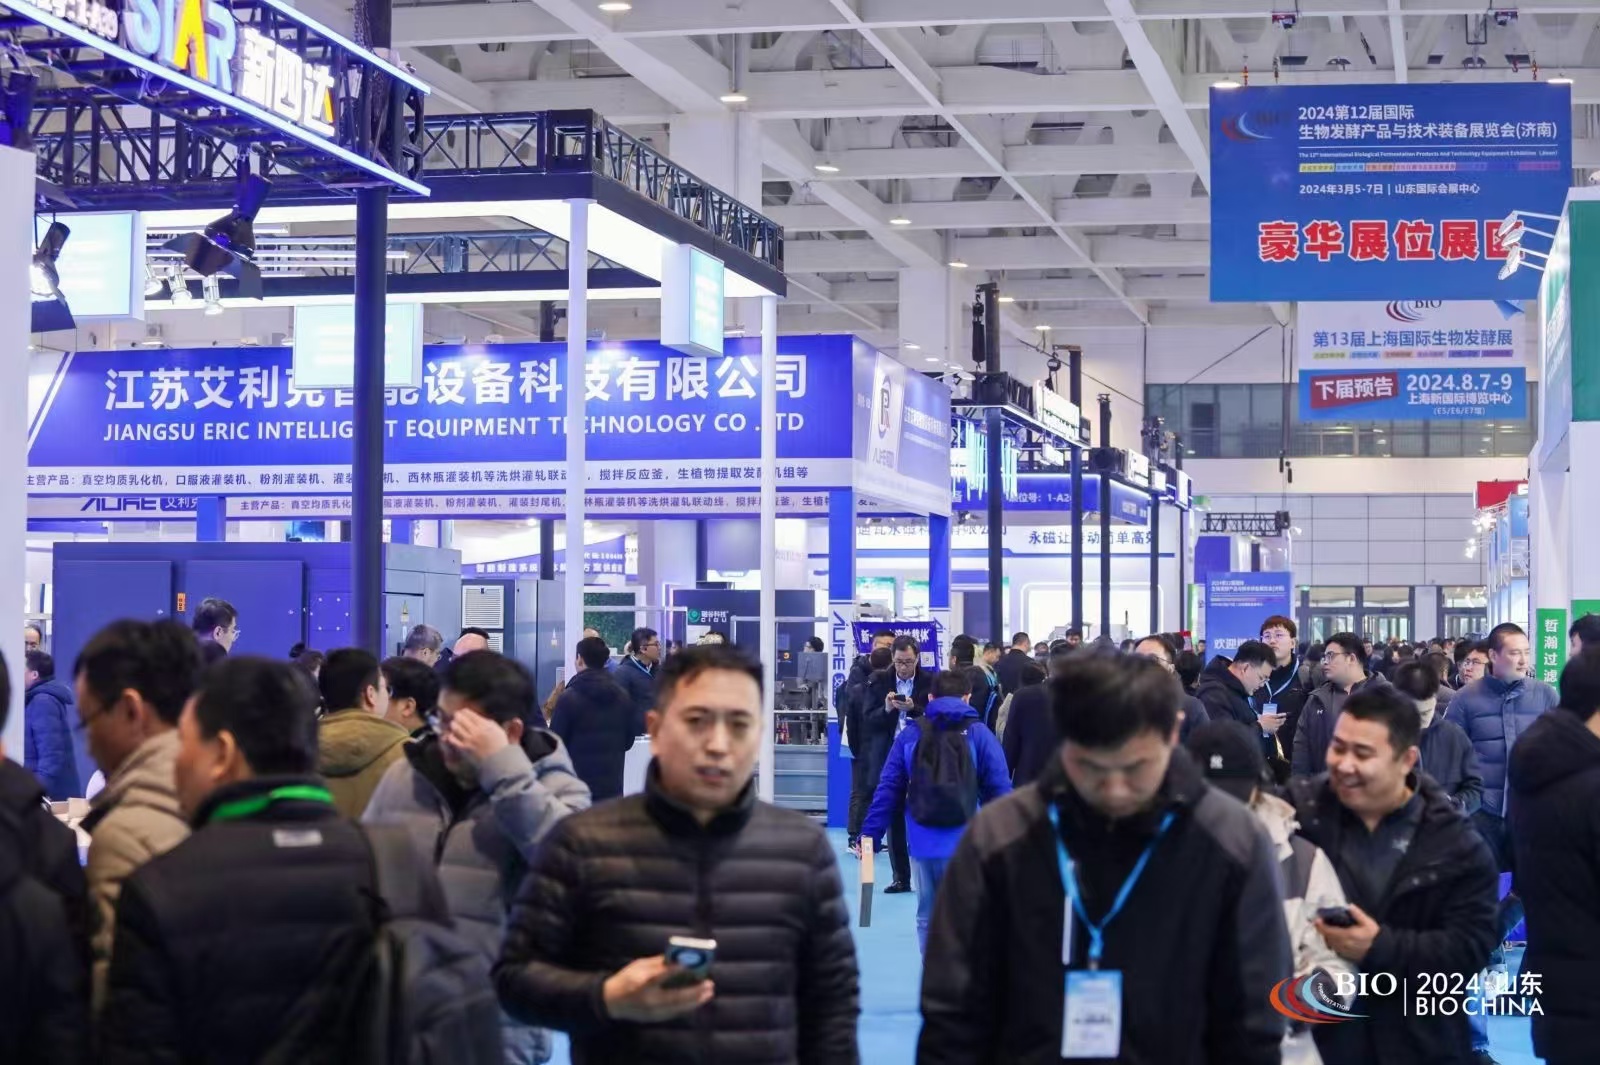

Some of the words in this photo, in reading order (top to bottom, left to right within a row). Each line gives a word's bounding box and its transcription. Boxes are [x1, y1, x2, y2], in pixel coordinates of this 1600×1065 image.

[238, 27, 335, 137] 新四达
[1299, 104, 1415, 121] 2024第12届国际
[1299, 122, 1558, 141] 生物发酵产品与技术装备展览会(济南)
[1299, 184, 1384, 195] 2024年3月5-7日
[1395, 183, 1480, 195] 山东国际会展中心
[1258, 219, 1525, 262] 豪华展位展区
[1312, 329, 1513, 348] 第13届上海国际生物发酵展
[104, 354, 807, 411] 江苏艾利克设备科技有限公司
[1315, 376, 1394, 401] 下届预告
[1406, 373, 1513, 391] 2024.8.7-9
[1407, 392, 1513, 406] 上海新国际博览中心
[103, 422, 196, 442] JIANGSU
[203, 422, 249, 441] ERIC
[258, 420, 398, 440] INTELLIGT
[406, 416, 540, 438] EQUIPMENT
[548, 413, 706, 435] THNOLOGY
[1543, 619, 1559, 691] 哲瀚过滤
